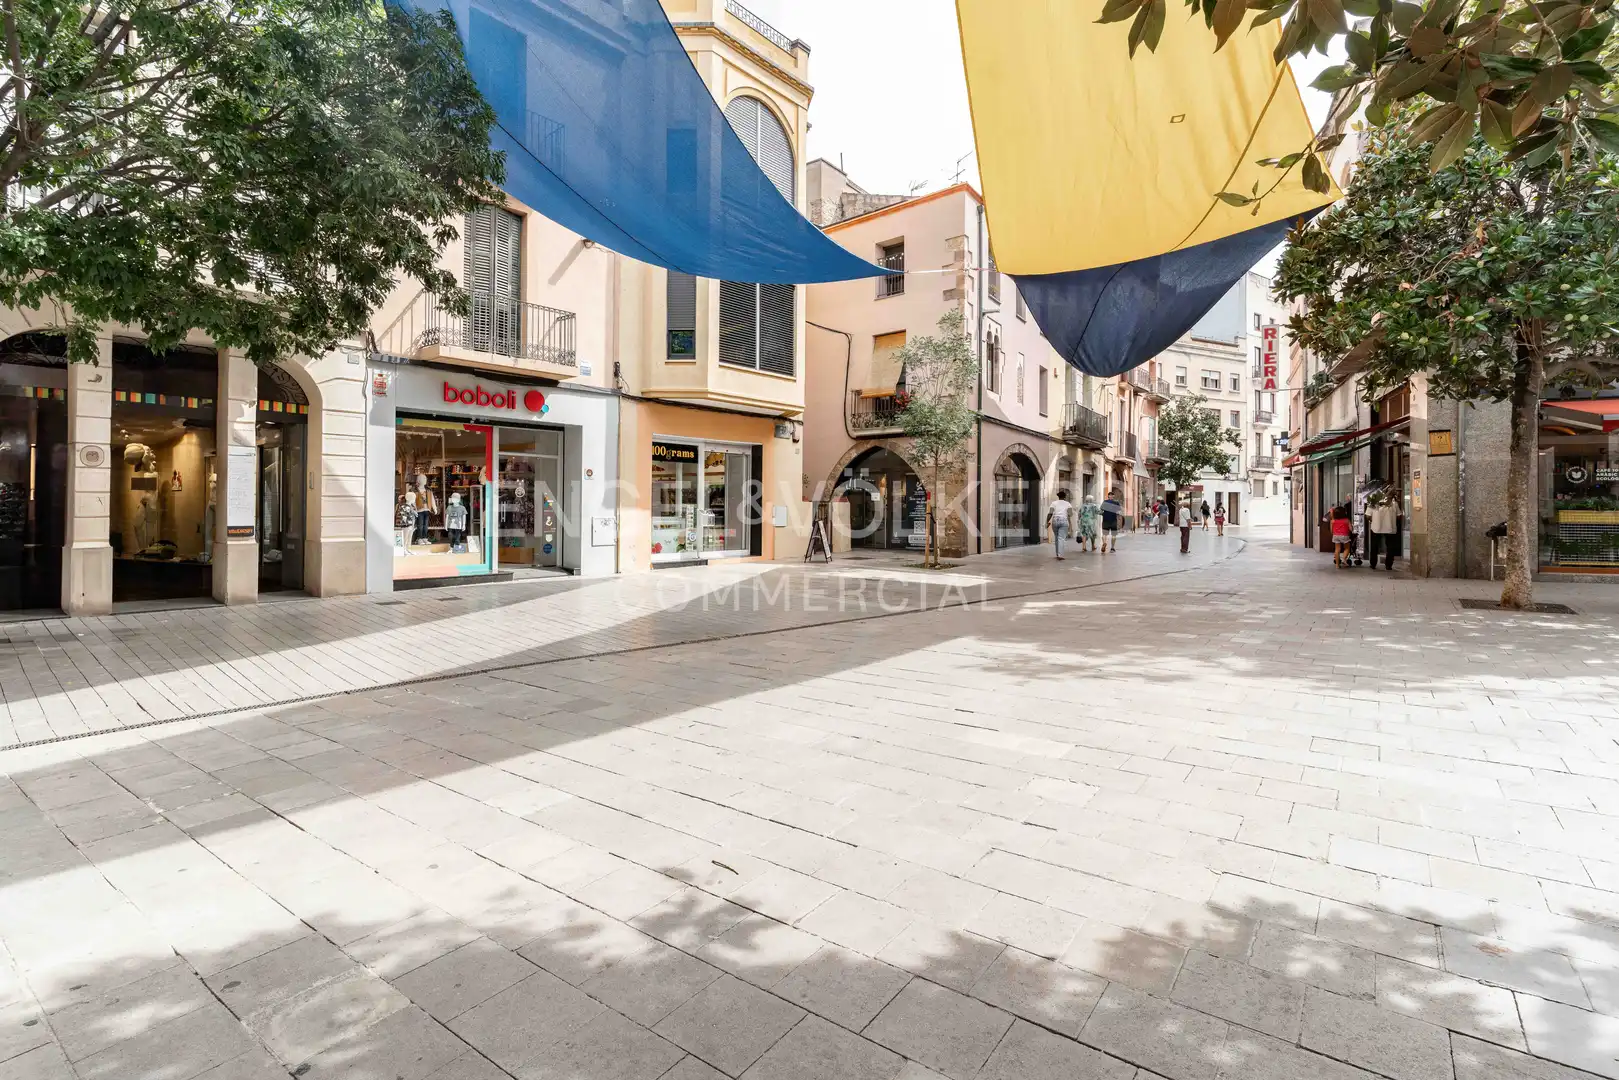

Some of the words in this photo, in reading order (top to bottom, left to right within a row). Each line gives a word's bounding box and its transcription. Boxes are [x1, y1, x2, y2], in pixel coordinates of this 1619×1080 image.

[1264, 328, 1277, 390] RIERA
[443, 381, 517, 410] boboli
[652, 445, 695, 460] 100grams
